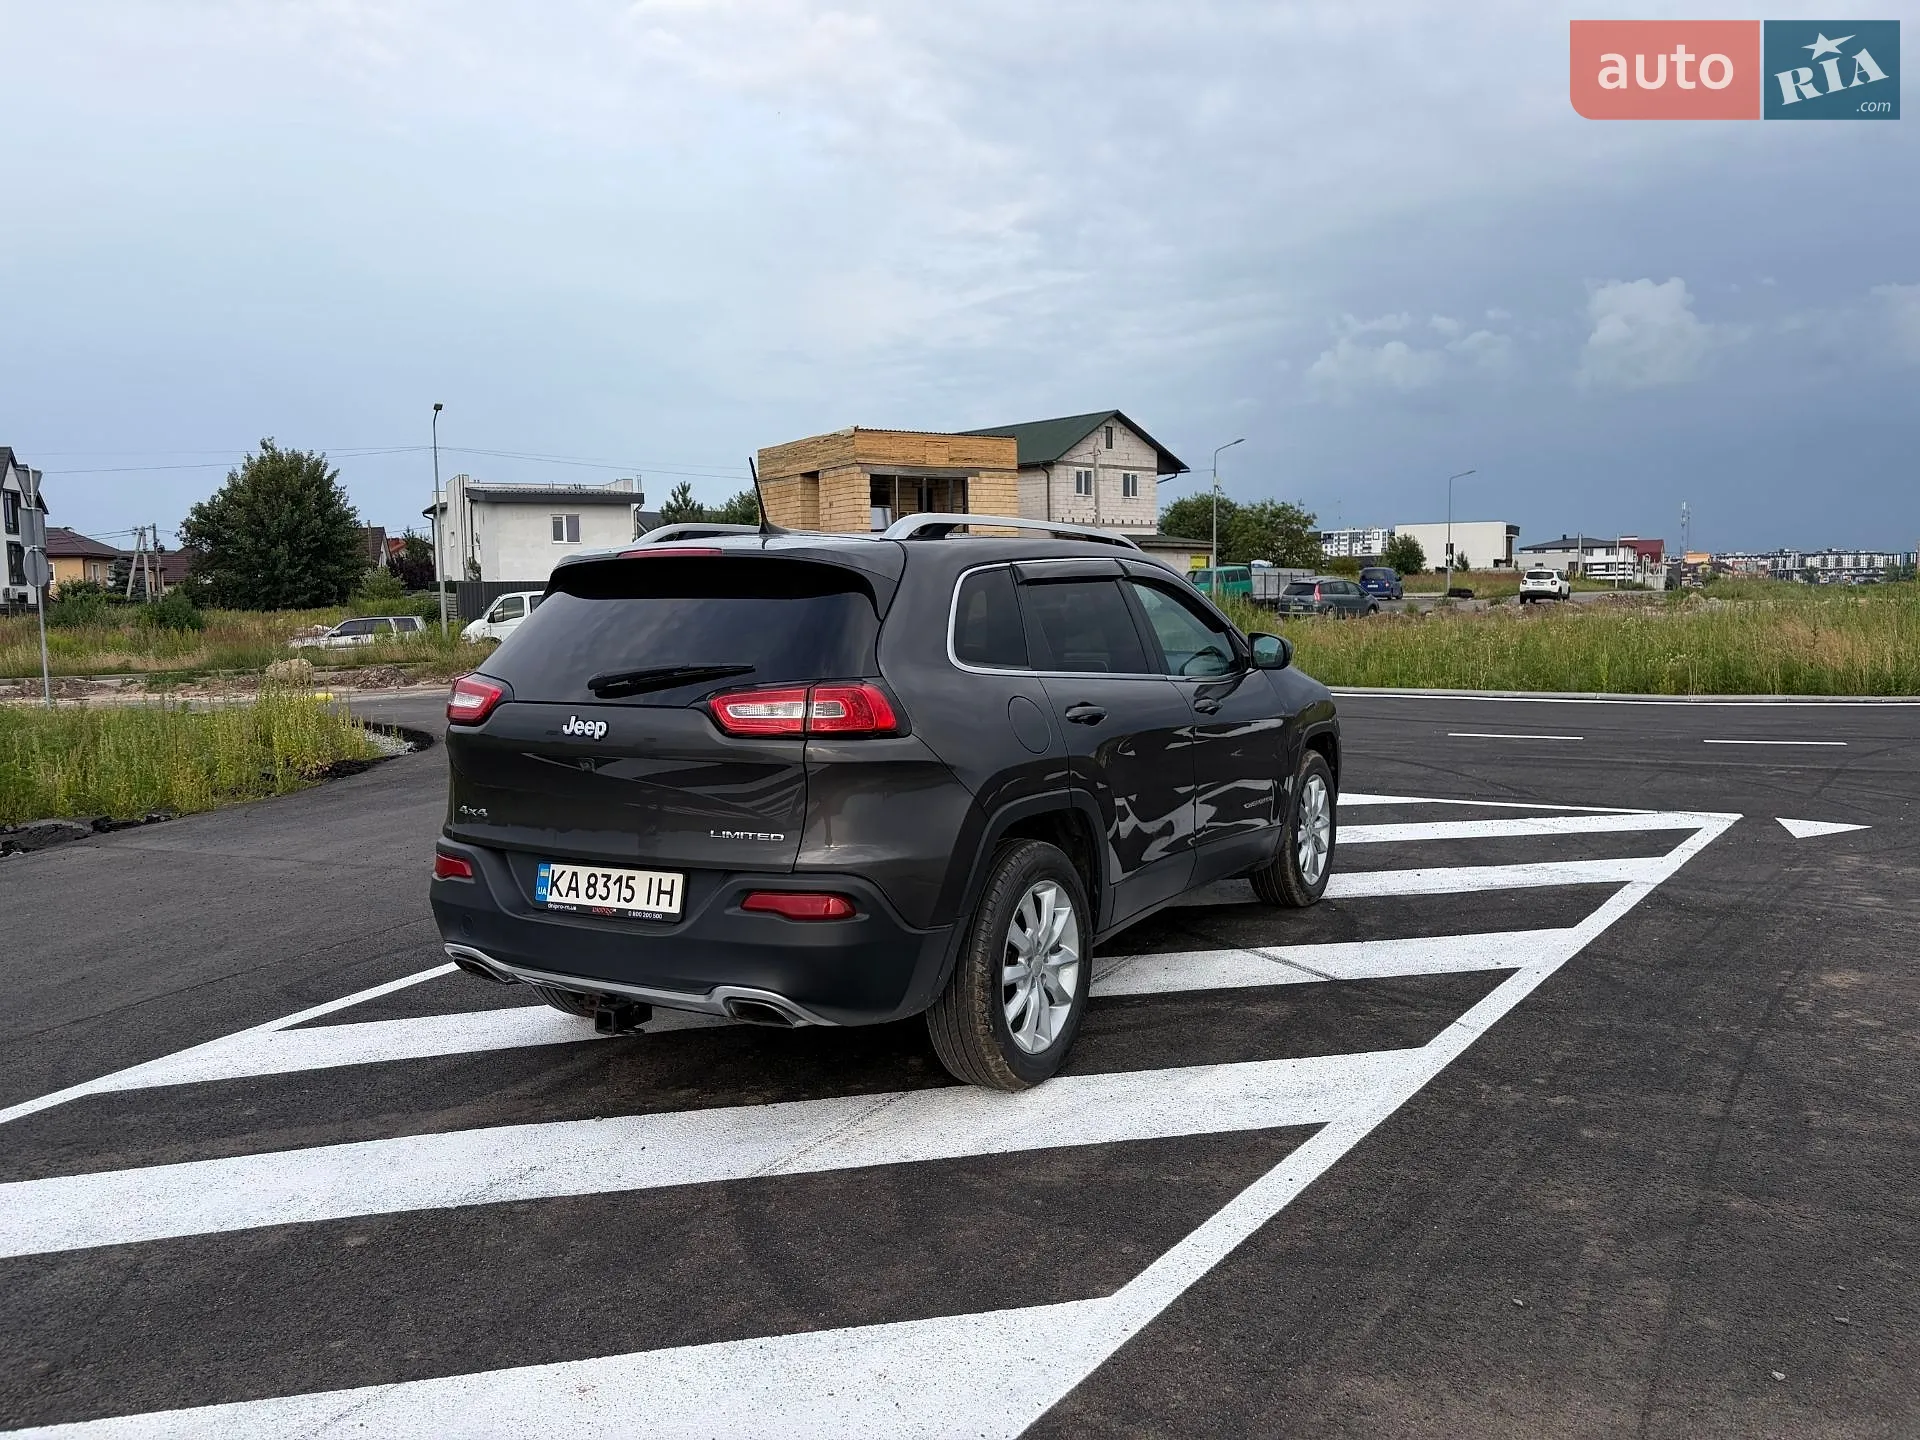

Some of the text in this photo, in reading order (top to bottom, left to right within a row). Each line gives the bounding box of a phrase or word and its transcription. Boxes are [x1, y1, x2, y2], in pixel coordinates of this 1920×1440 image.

[562, 715, 607, 740] Jeep
[710, 829, 785, 841] LIMITED
[537, 886, 547, 896] UA
[549, 869, 675, 907] KA 8315 IH
